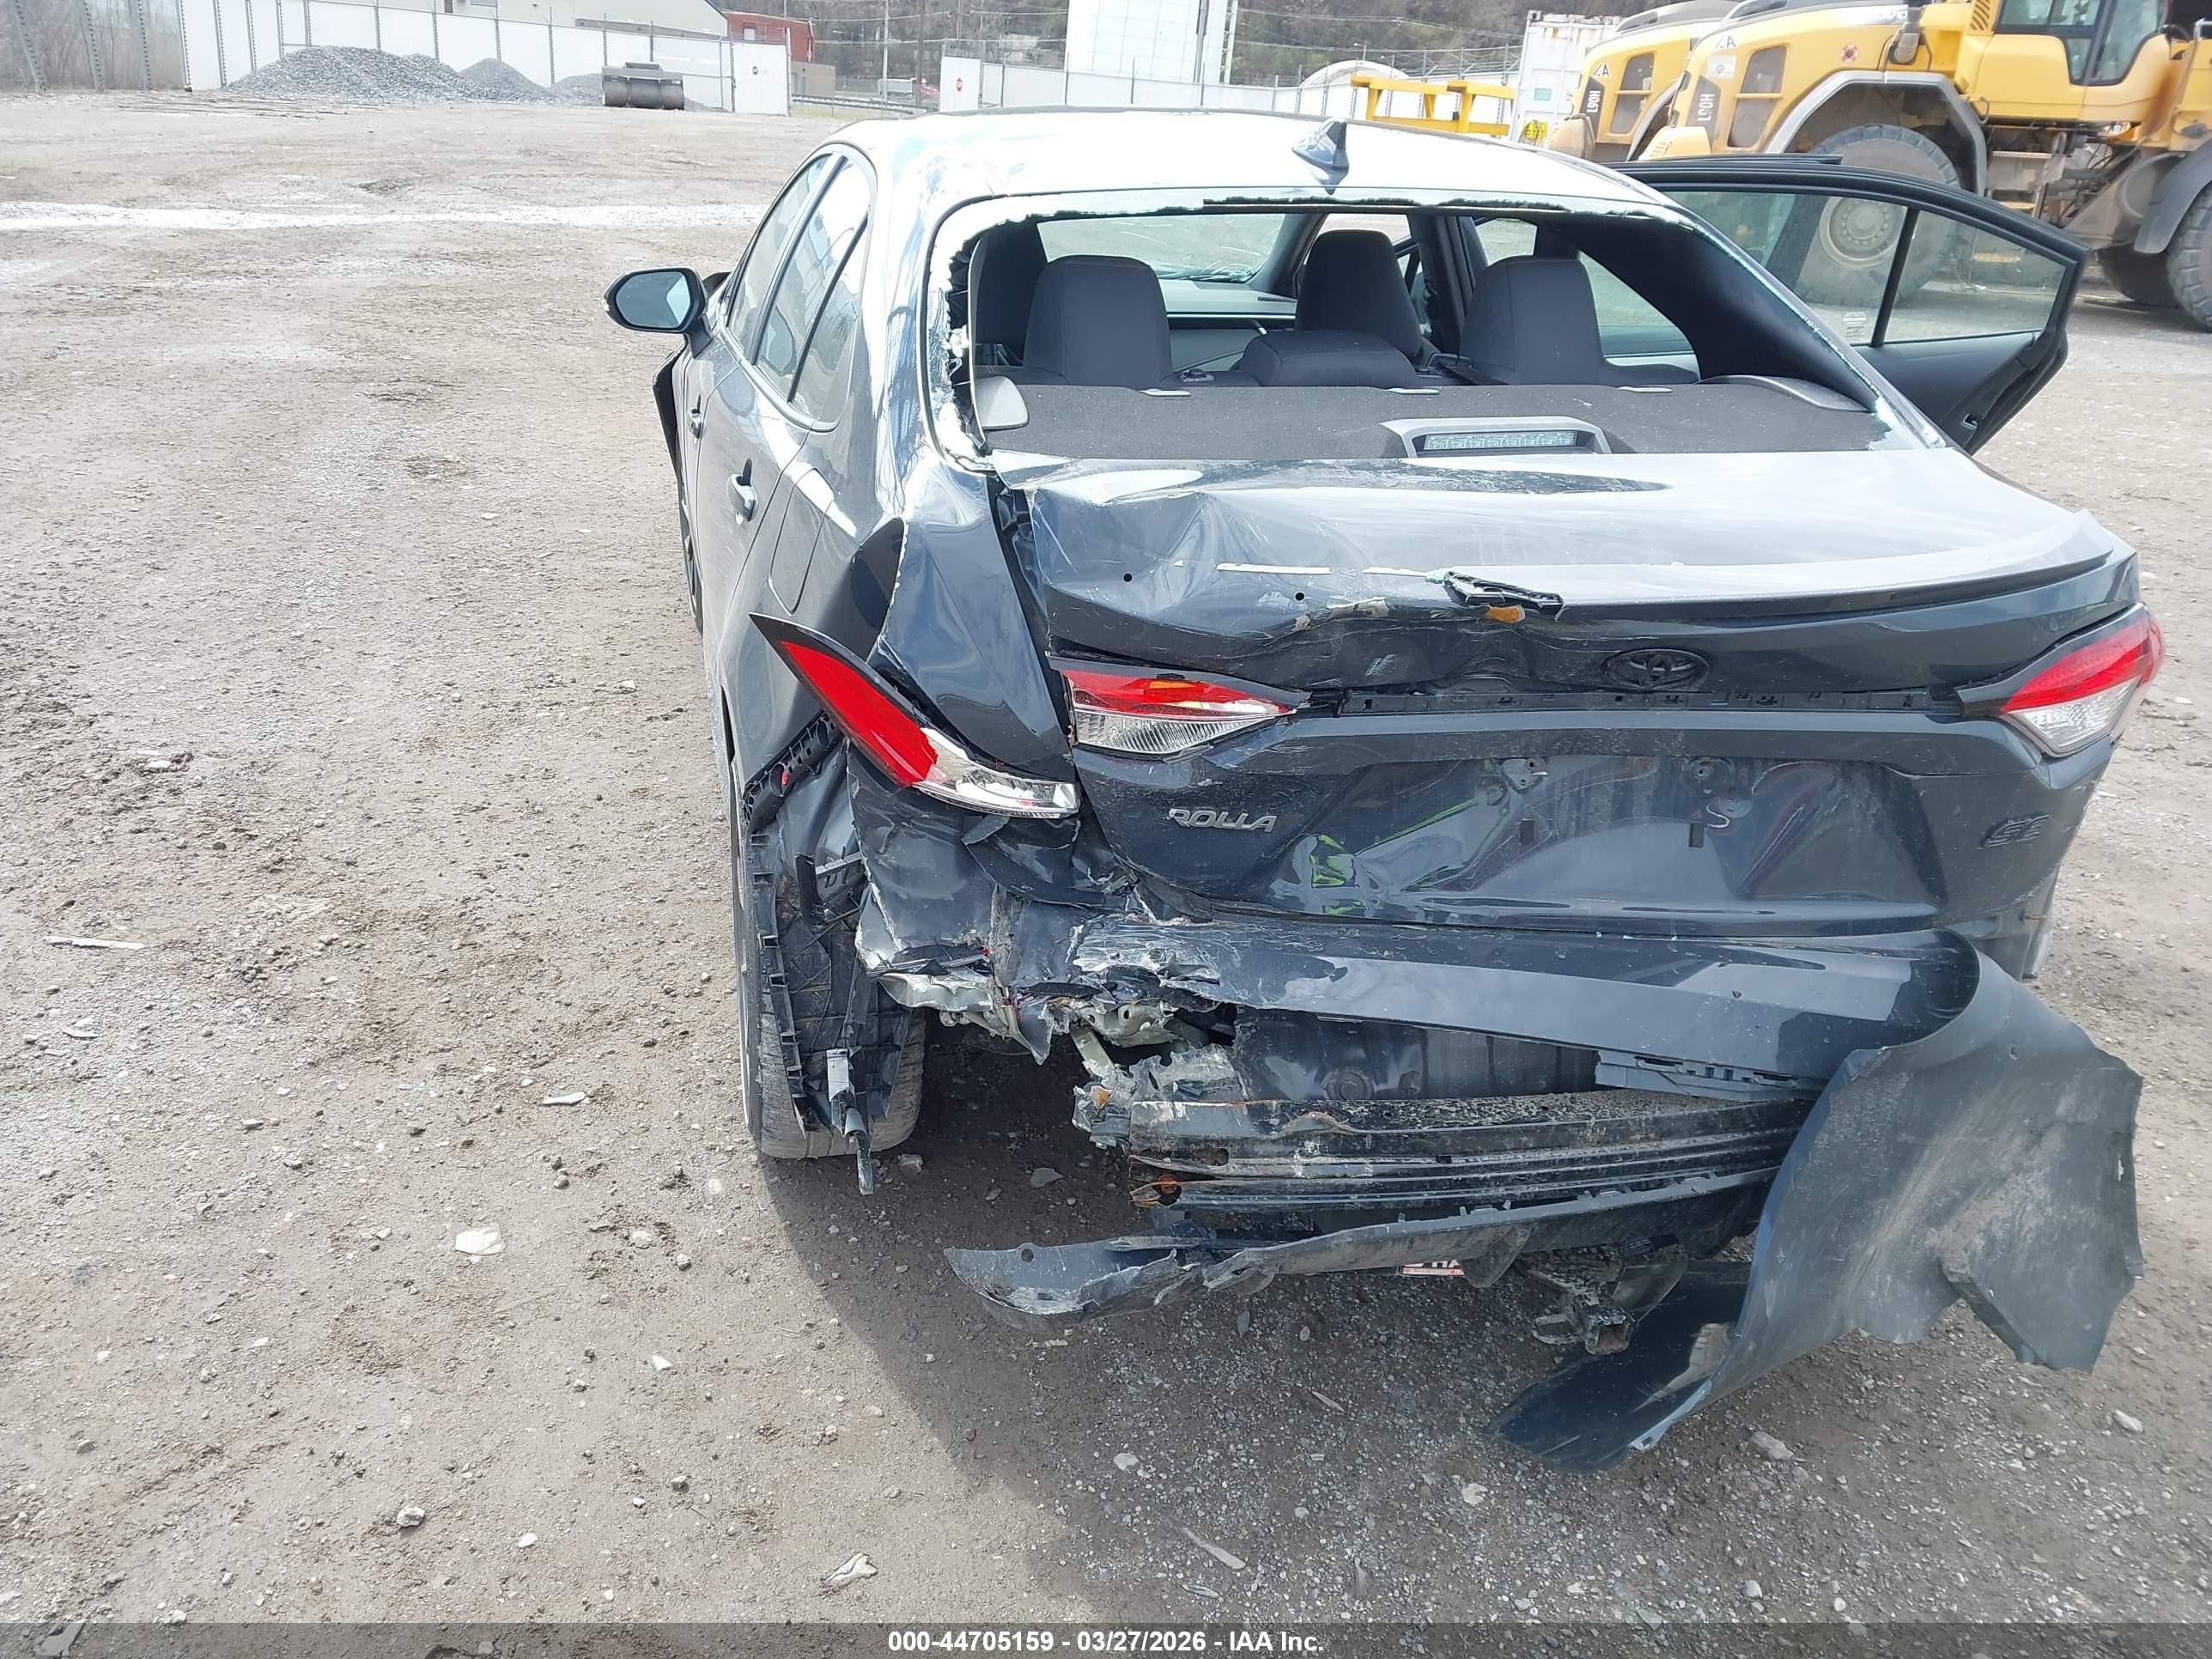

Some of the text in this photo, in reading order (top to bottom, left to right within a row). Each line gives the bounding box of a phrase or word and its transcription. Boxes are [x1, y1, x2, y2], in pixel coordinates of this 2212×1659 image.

[1586, 90, 1601, 112] L90H
[1697, 93, 1716, 121] L90H
[1169, 808, 1277, 832] ROLLA
